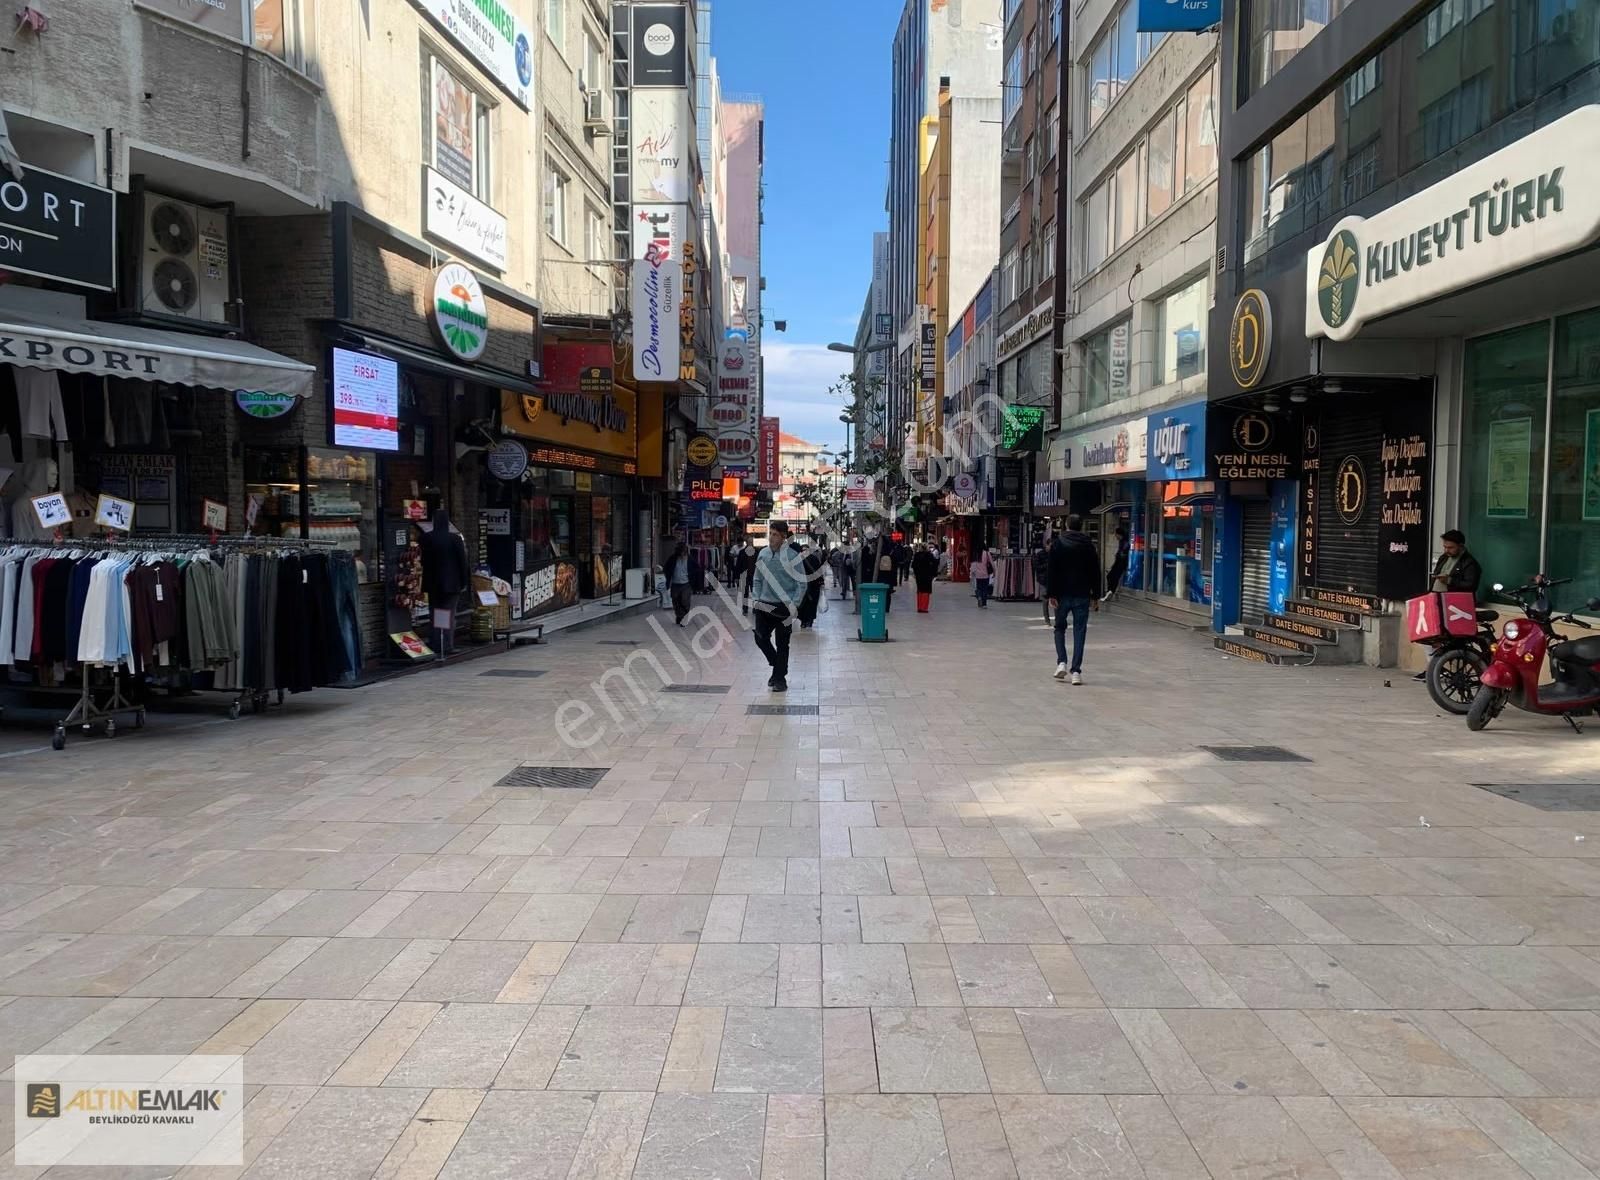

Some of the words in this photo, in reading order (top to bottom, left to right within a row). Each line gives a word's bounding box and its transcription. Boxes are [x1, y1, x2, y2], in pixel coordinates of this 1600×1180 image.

[1183, 0, 1208, 9] kurs
[663, 275, 673, 313] Güzellik
[353, 365, 380, 379] FIRSAT
[1154, 416, 1190, 464] uğur
[1215, 453, 1247, 465] YENİ
[1251, 453, 1291, 465] NESİL
[1304, 459, 1319, 470] DATE
[1219, 467, 1286, 479] EĞLENCE
[692, 480, 721, 491] PİLİÇ
[1304, 473, 1315, 577] İSTANBUL
[1318, 592, 1335, 602] DATE
[1336, 593, 1368, 608] İSTANBUL
[1297, 606, 1313, 617] DATE
[1314, 607, 1346, 622] İSTANBUL
[1275, 619, 1291, 630] DATE
[1292, 620, 1323, 638] İSTANBUL
[1255, 632, 1270, 642] DATE
[1225, 642, 1240, 655] DATE
